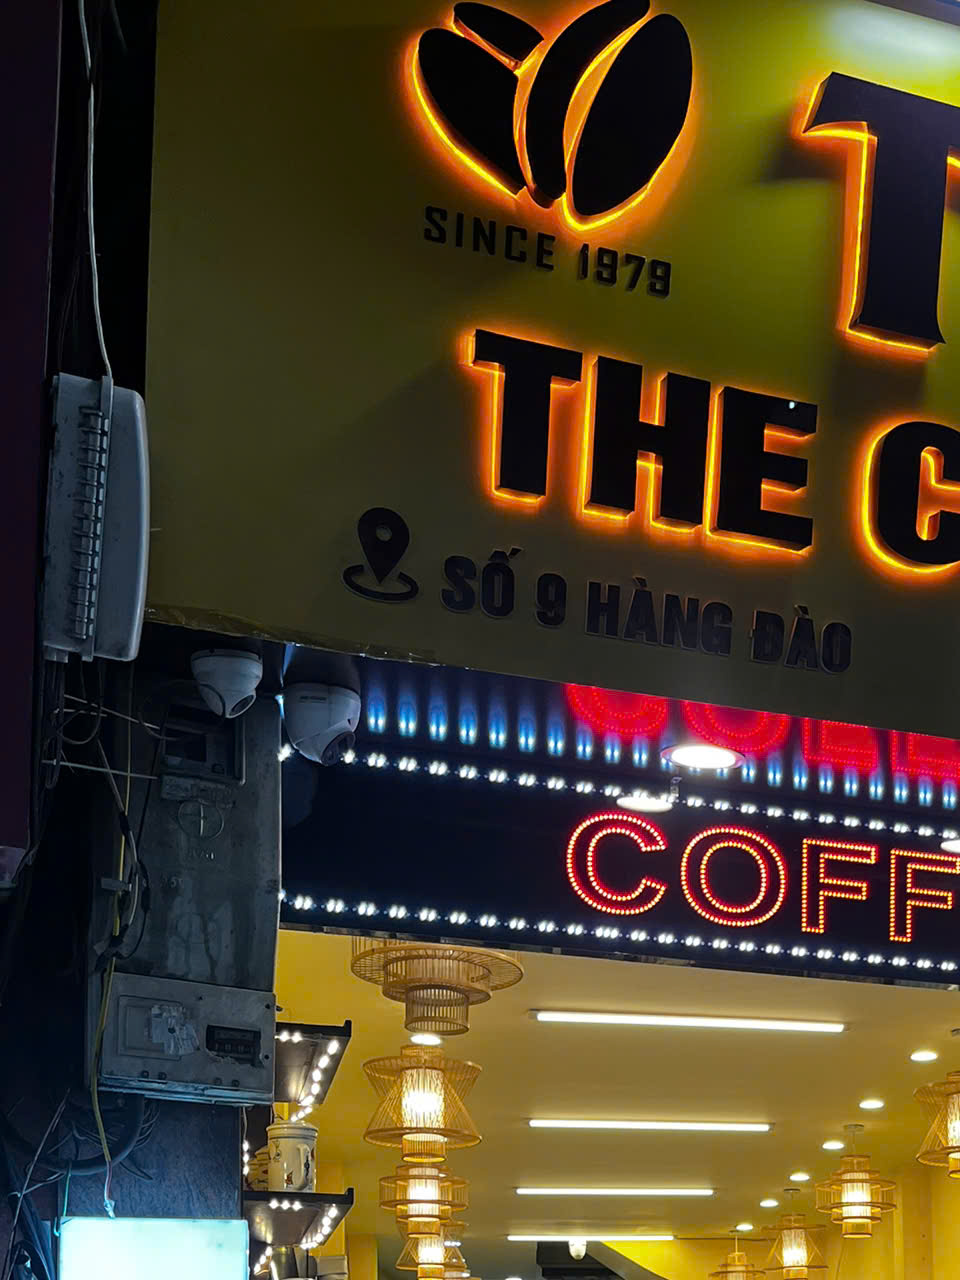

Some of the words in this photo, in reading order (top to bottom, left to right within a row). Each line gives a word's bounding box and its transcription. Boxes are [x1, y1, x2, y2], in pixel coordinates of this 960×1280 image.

[422, 205, 556, 272] SINCE
[577, 242, 672, 298] 1979
[462, 327, 818, 558] THE
[440, 547, 524, 620] SỐ
[535, 572, 568, 627] 9
[585, 575, 732, 658] HÀNG
[750, 603, 853, 675] ĐÀO
